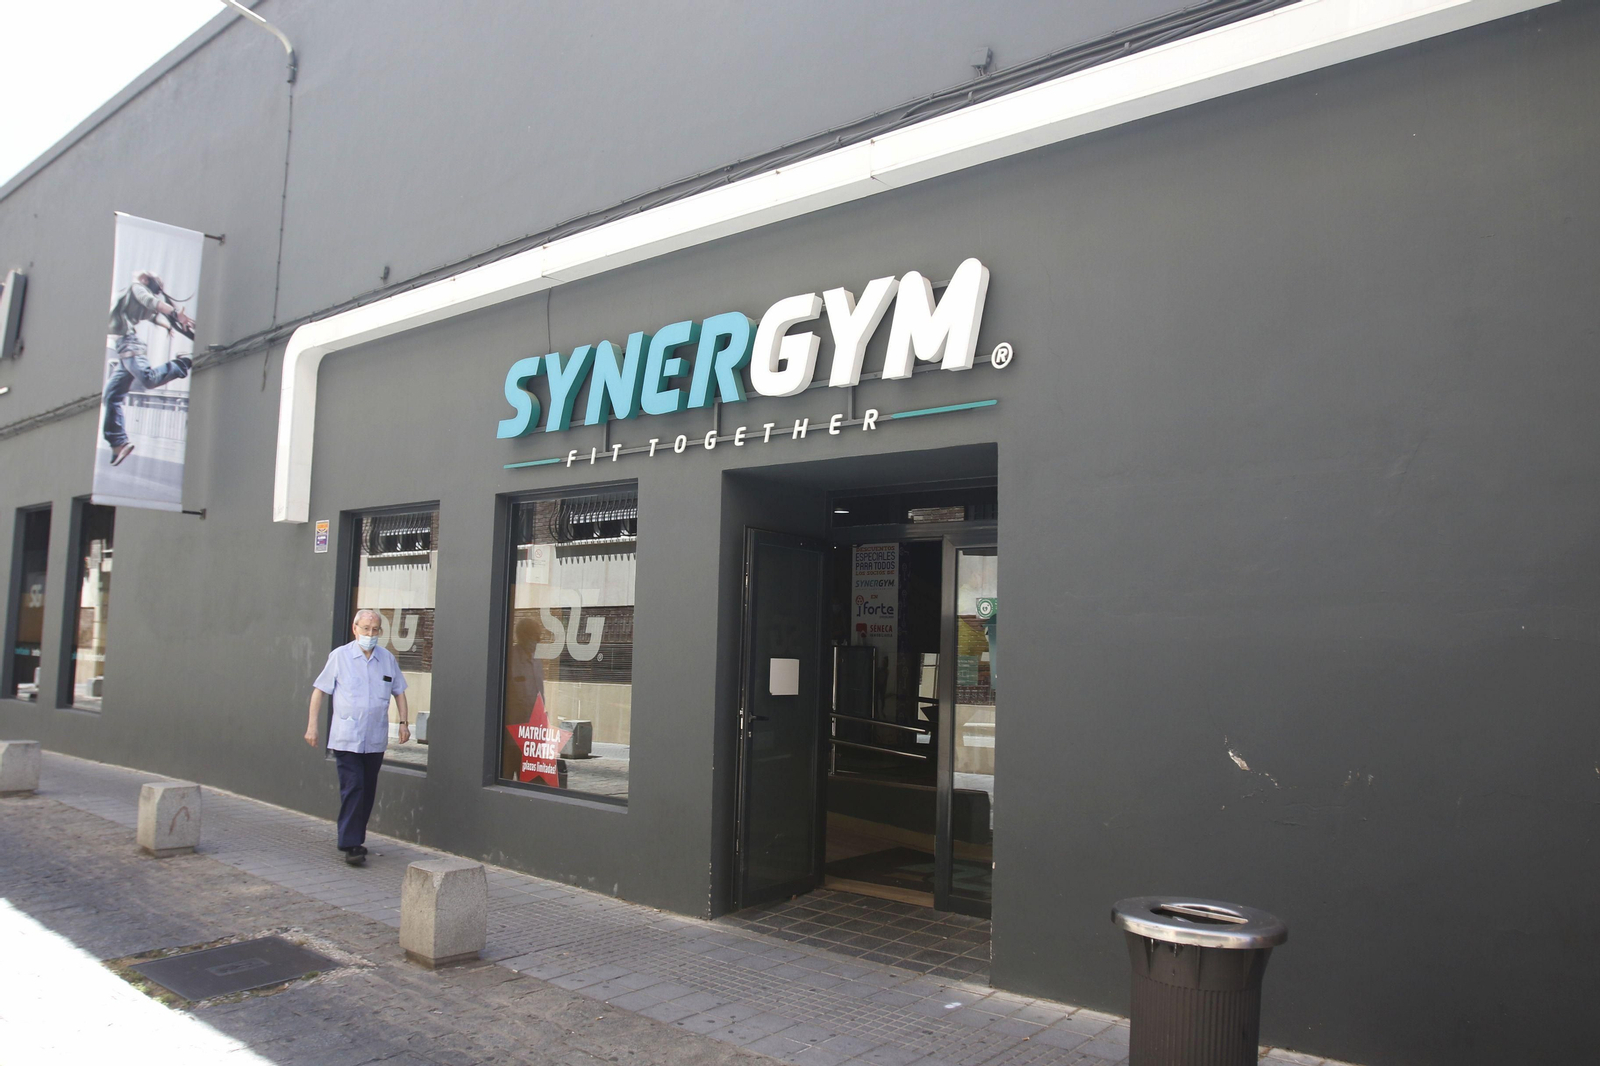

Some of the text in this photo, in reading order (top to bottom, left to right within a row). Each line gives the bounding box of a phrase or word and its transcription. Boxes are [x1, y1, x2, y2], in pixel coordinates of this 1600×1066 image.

[566, 409, 879, 467] FIT TOGETHER
[856, 552, 896, 561] ESPECIALES
[856, 562, 896, 570] PARA TODOS
[518, 724, 561, 743] MATRÍCULA
[523, 740, 556, 760] GRATIS
